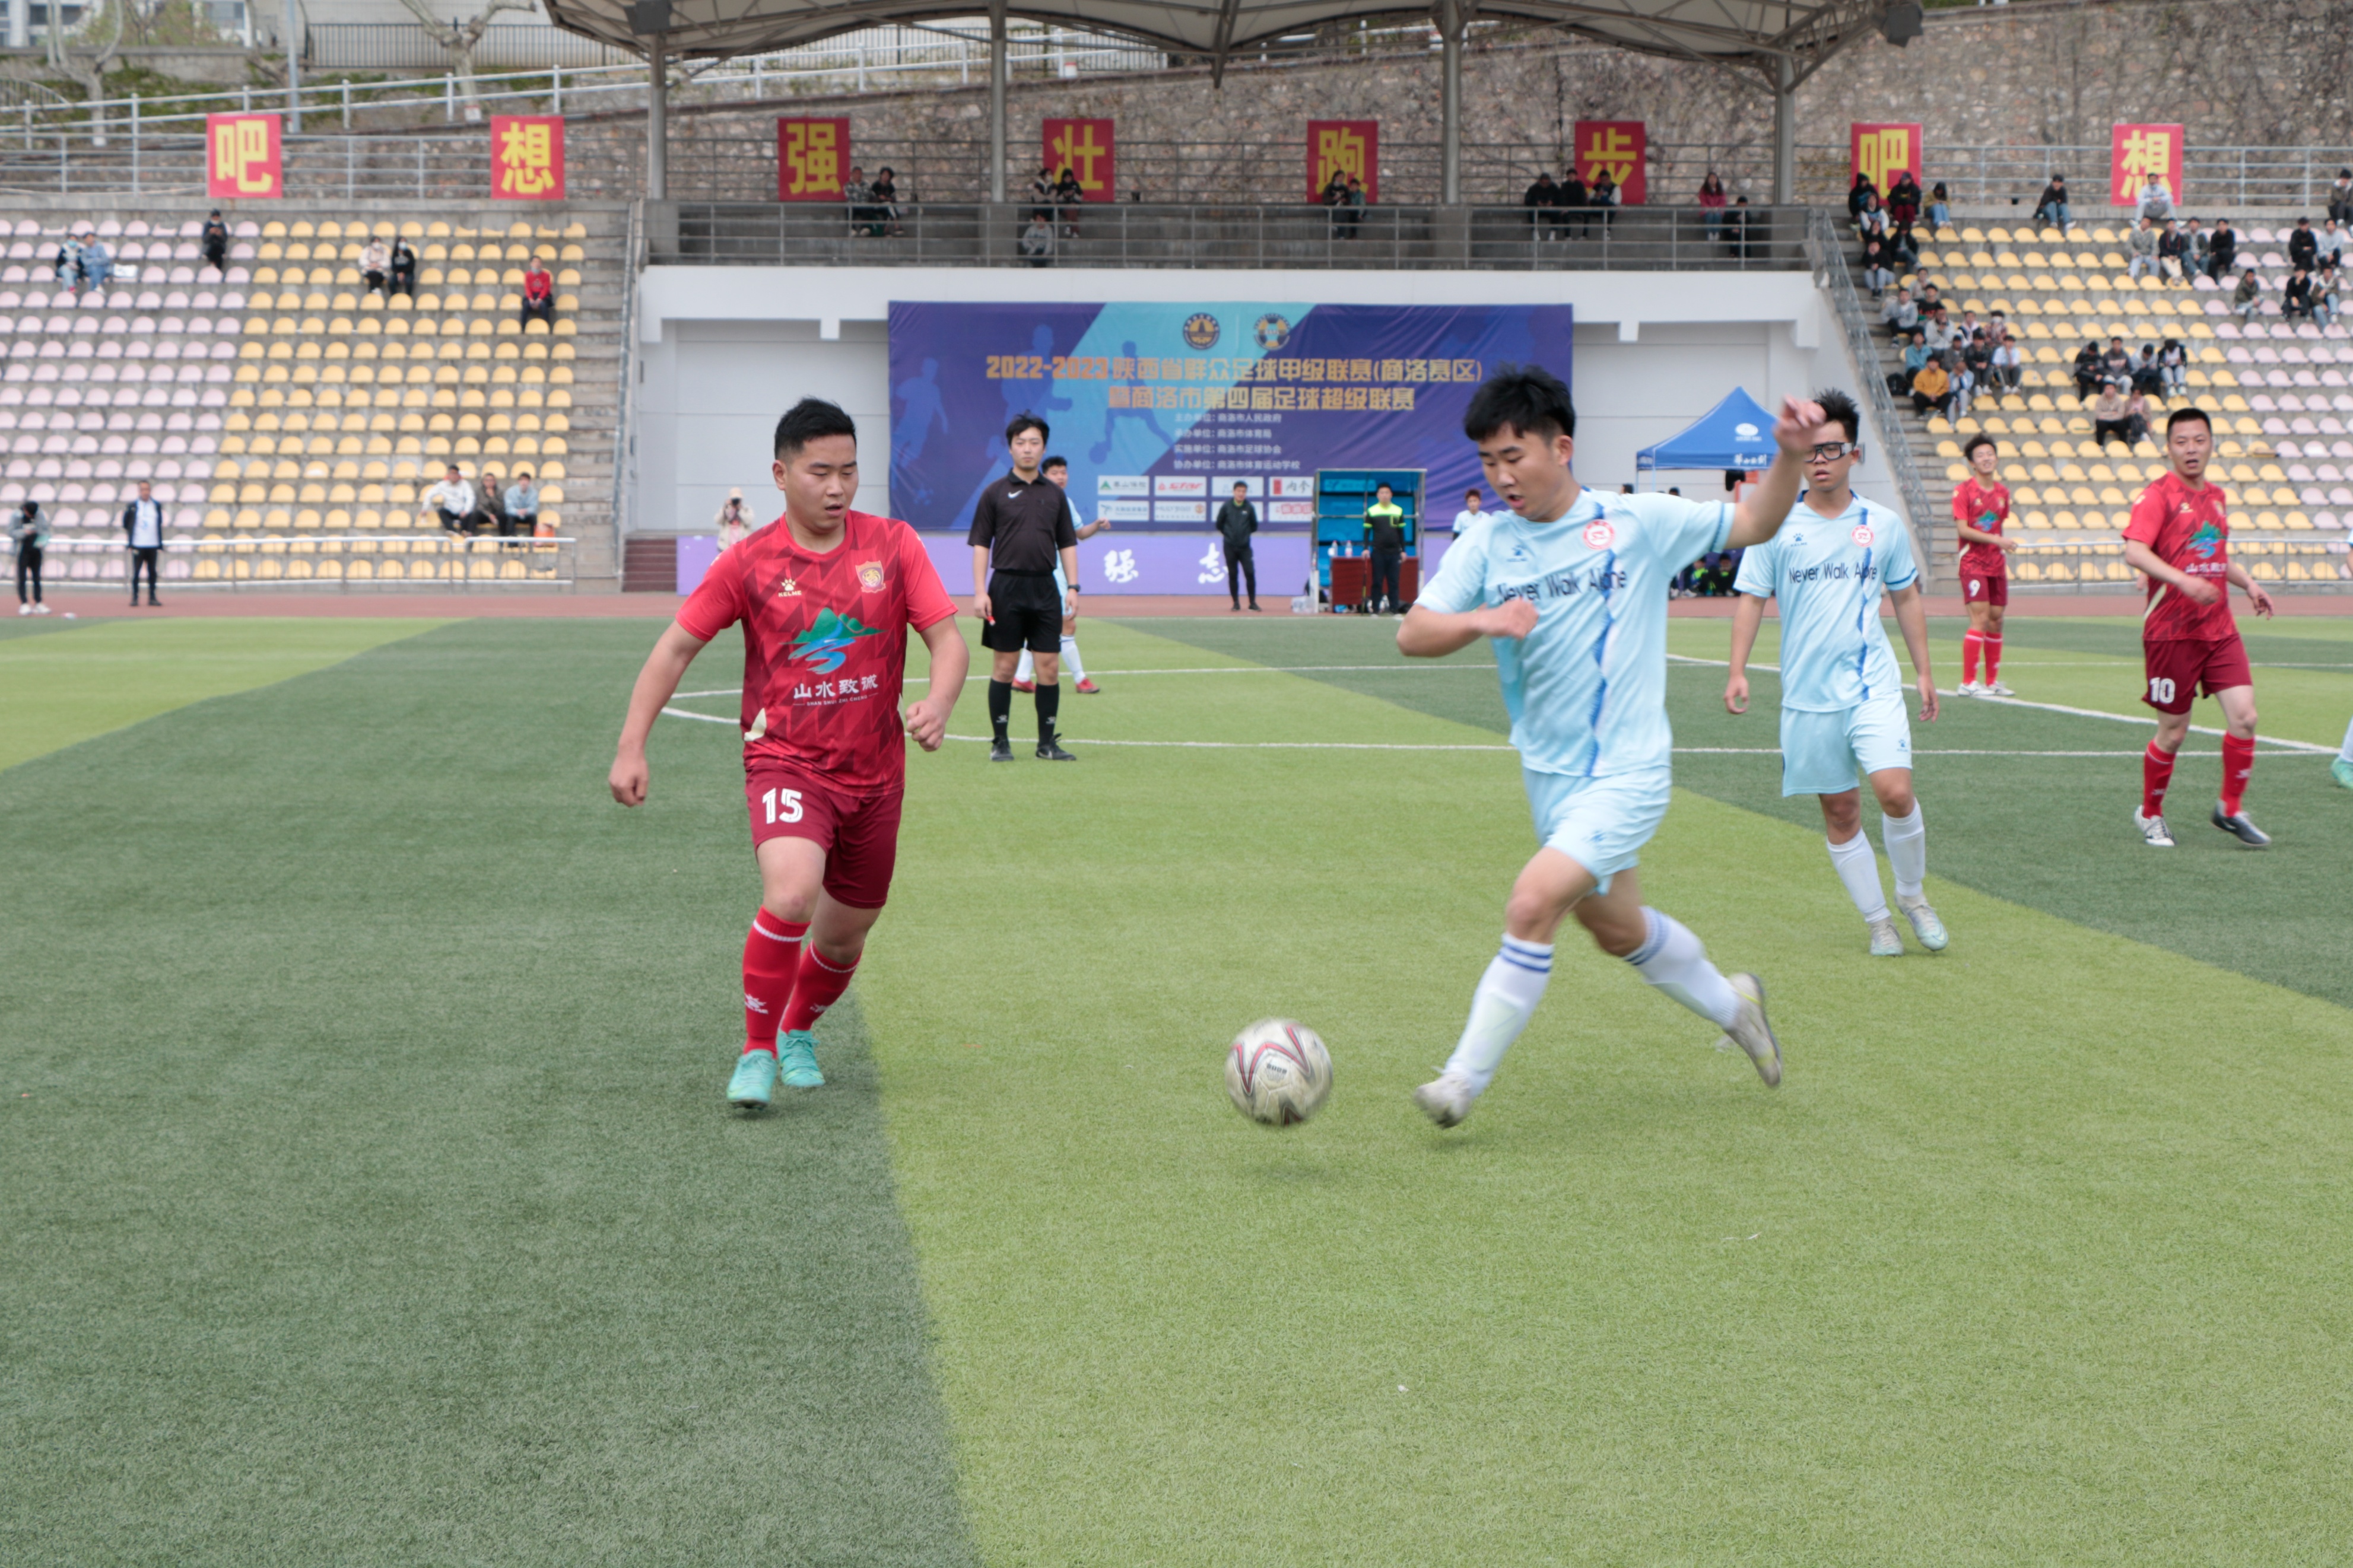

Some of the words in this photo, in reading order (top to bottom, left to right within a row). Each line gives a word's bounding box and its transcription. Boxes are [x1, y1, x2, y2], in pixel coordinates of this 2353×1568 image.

[215, 119, 273, 193] 吧
[500, 122, 555, 194] 想
[786, 122, 842, 194] 强
[1052, 125, 1105, 190] 壮
[1316, 127, 1368, 196] 跑
[1583, 127, 1637, 198] 步
[1859, 129, 1909, 200] 吧
[2120, 129, 2173, 199] 想
[1108, 386, 1415, 410] 暨商洛市第四届足球超级联赛
[1789, 567, 1819, 584] Never
[1824, 562, 1849, 580] Walk
[1854, 561, 1878, 580] Alone
[1968, 579, 1981, 597] 9
[793, 674, 878, 699] 山水致诚
[2149, 677, 2176, 704] 10
[762, 787, 804, 824] 15
